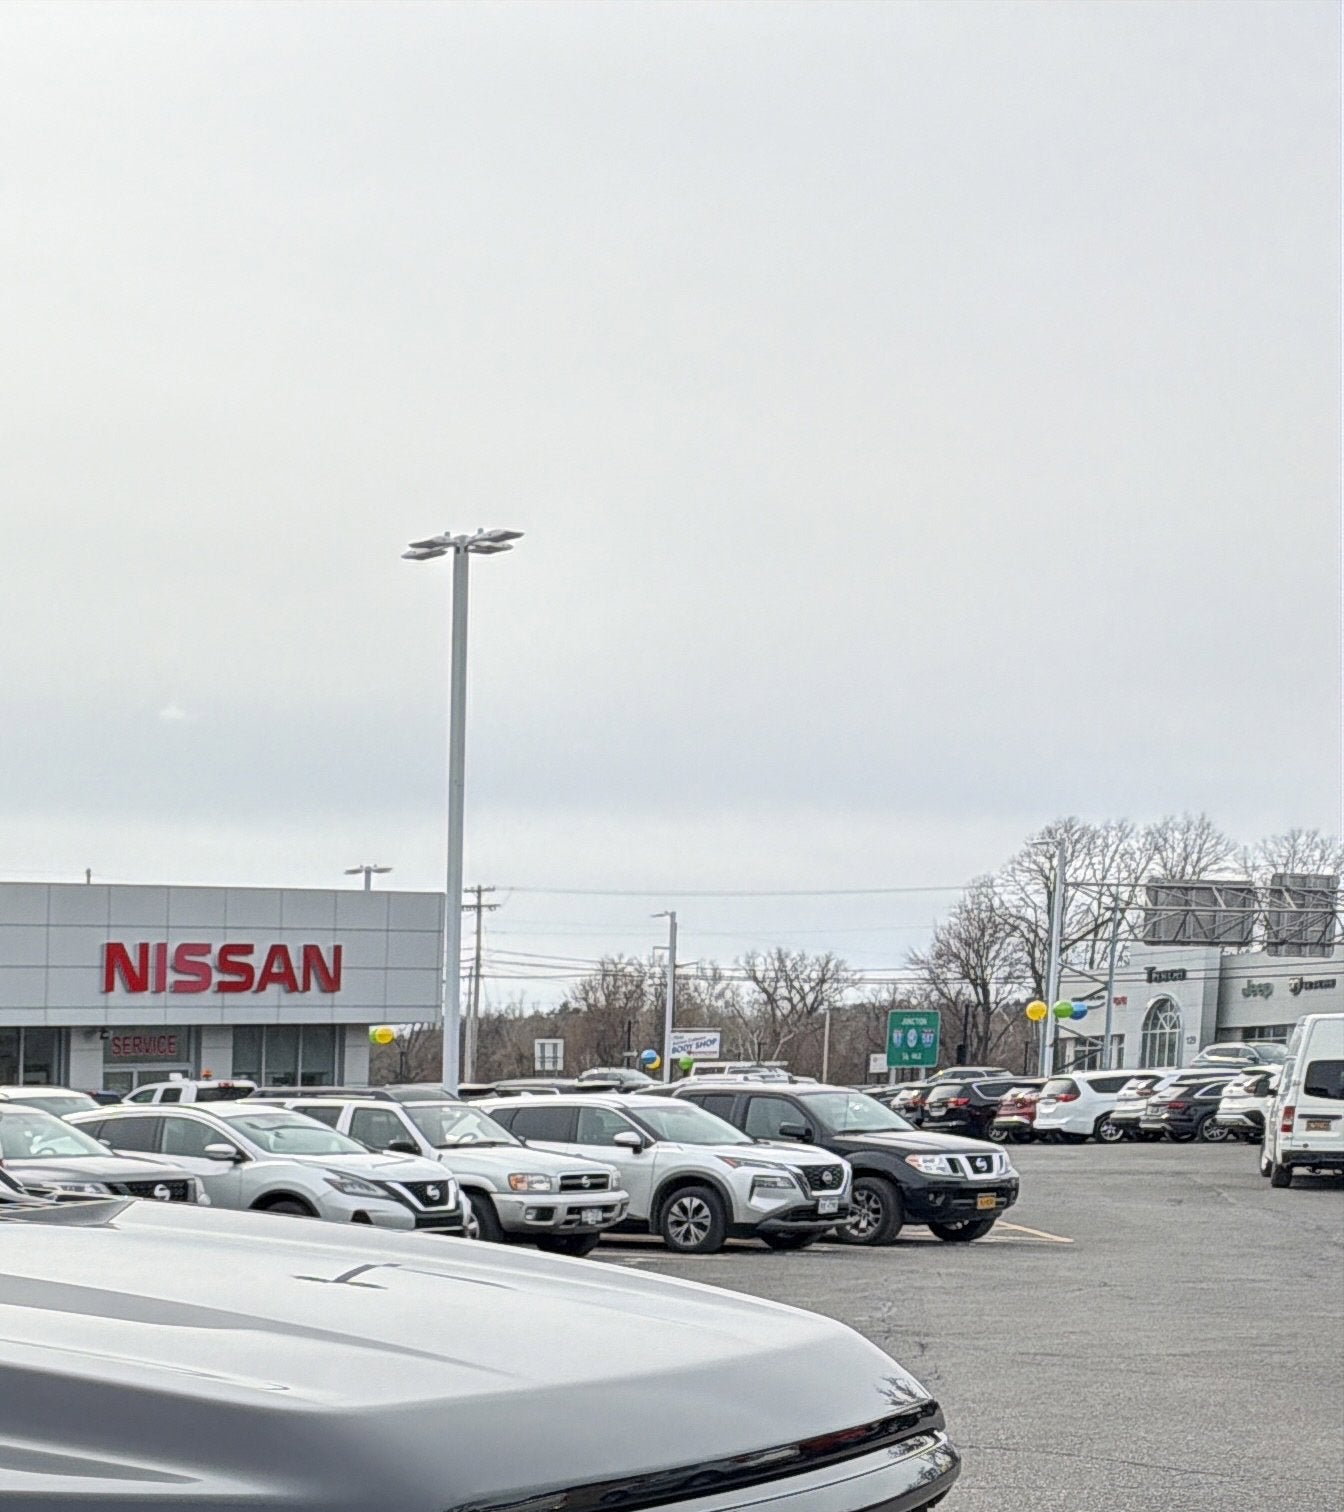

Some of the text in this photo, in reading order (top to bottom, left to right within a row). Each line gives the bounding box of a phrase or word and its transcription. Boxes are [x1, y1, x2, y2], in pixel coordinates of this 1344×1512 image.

[104, 942, 342, 993] NISSAN
[112, 1035, 176, 1056] SERVICE
[672, 1043, 693, 1054] BODY
[695, 1038, 717, 1049] SHOP
